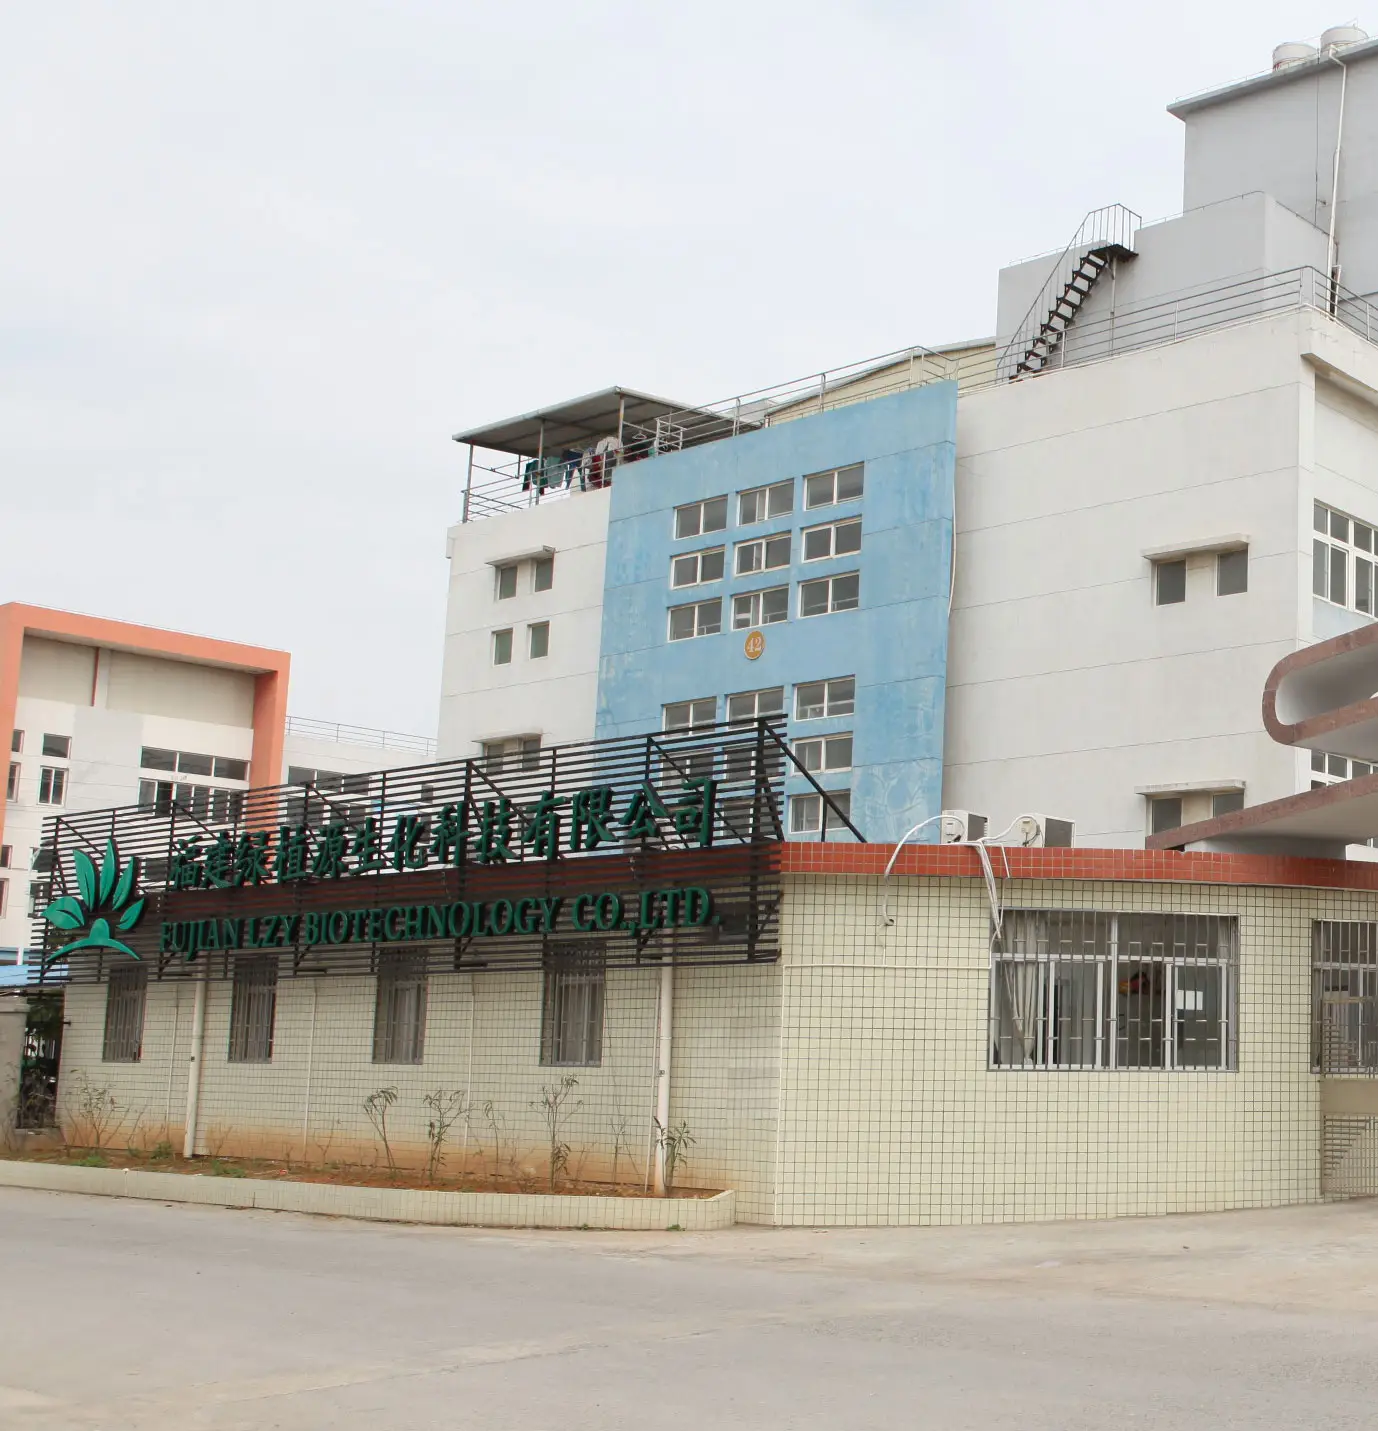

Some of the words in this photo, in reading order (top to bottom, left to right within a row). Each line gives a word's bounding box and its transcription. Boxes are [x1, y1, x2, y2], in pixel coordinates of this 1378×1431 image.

[159, 917, 243, 962] FUJIAN
[248, 914, 299, 948] LZY
[303, 895, 561, 946] BIOTECHNOLOGY
